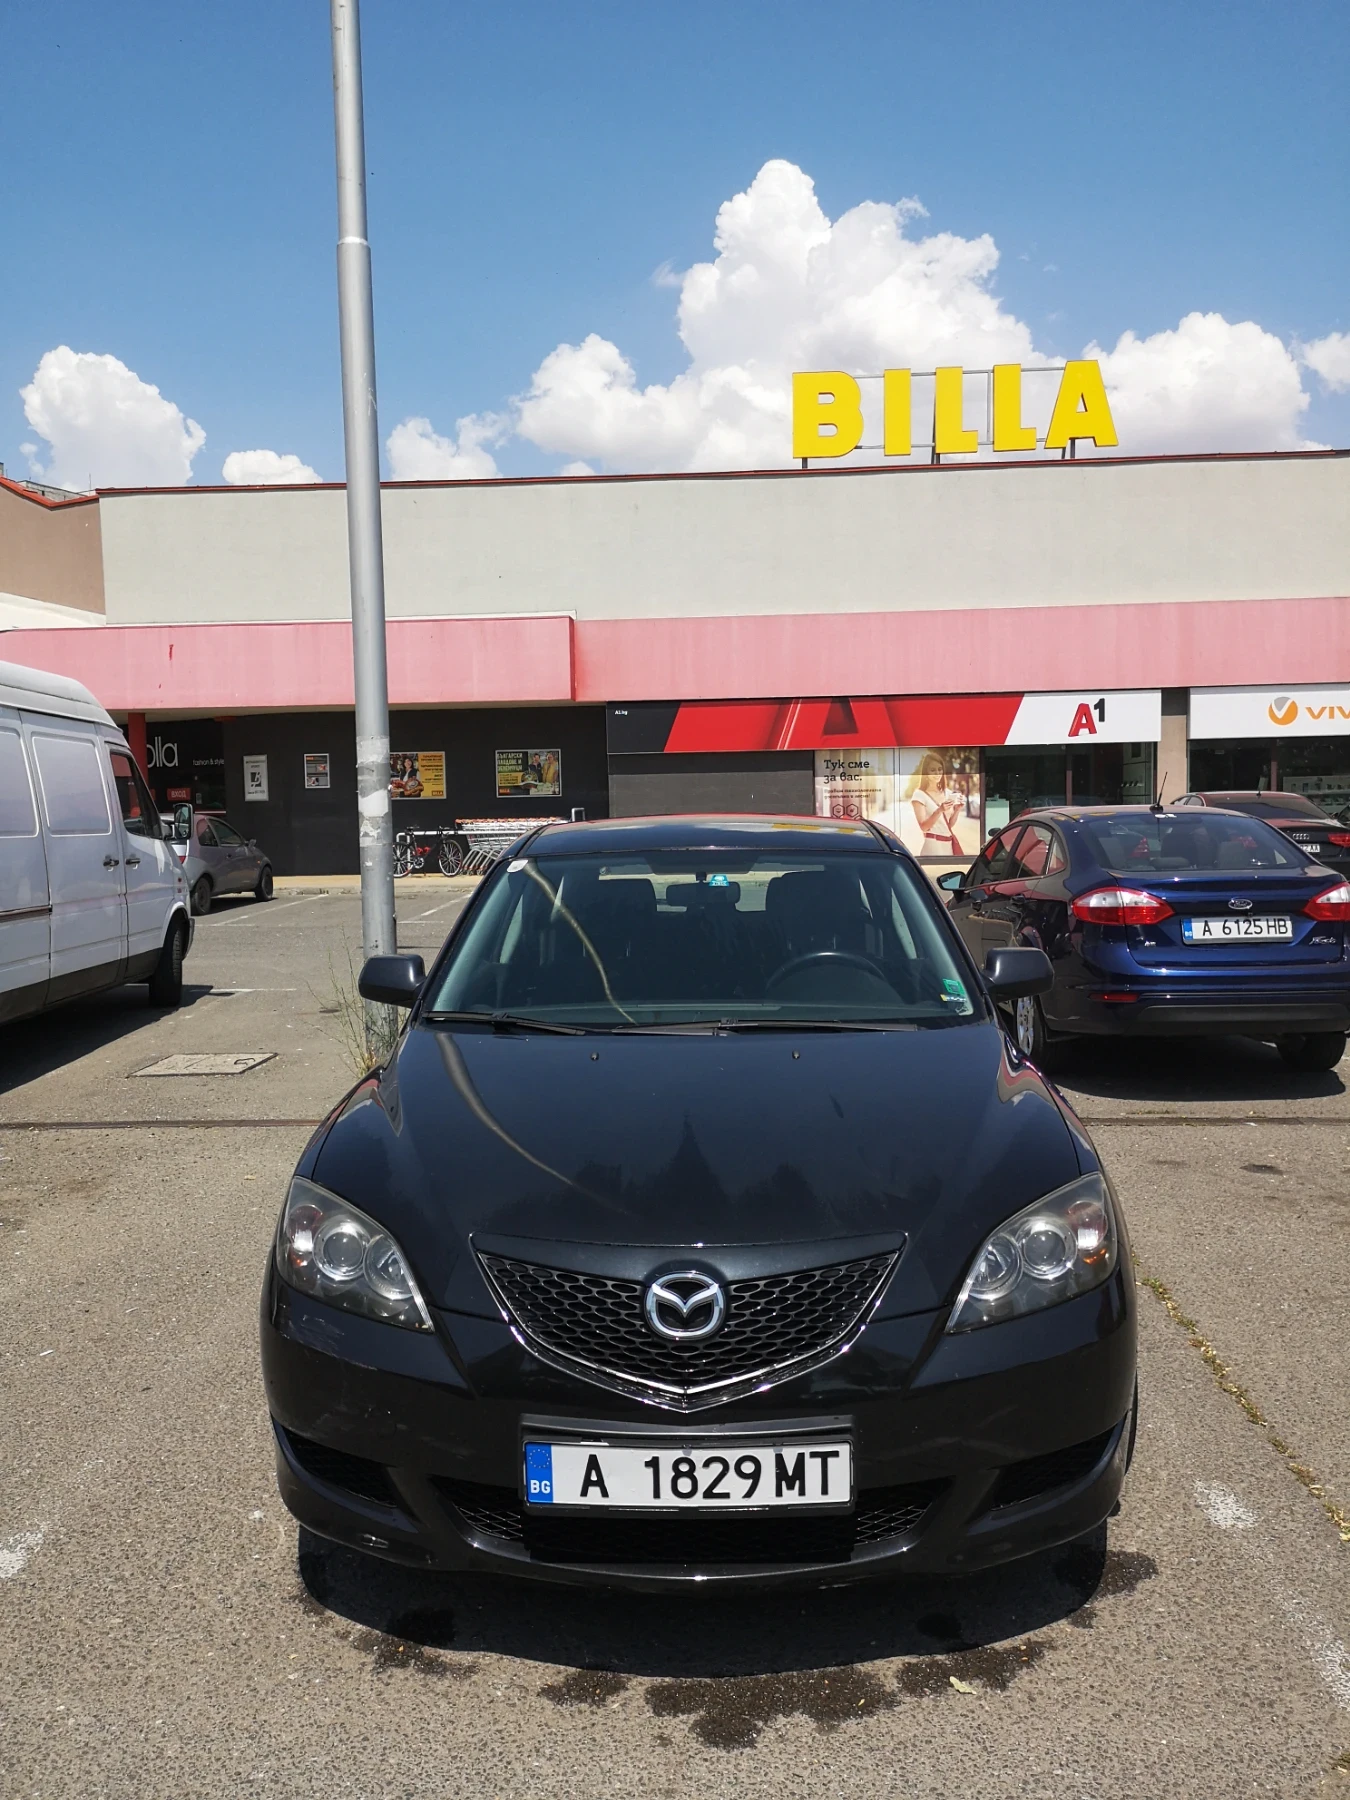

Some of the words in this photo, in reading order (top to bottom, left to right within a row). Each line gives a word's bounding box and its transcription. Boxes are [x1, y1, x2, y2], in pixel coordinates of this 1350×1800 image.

[792, 360, 1119, 459] BILLA
[1068, 698, 1105, 737] A1
[1305, 705, 1350, 720] VIV
[824, 759, 845, 771] Тук
[847, 761, 870, 769] сме
[824, 774, 837, 784] за
[840, 771, 863, 782] вас.
[171, 790, 187, 799] ВХОД
[1202, 920, 1212, 936] A
[1222, 919, 1263, 936] 6125
[1267, 918, 1288, 935] HB
[579, 1454, 610, 1498] A
[644, 1454, 762, 1499] 1829
[775, 1450, 840, 1498] MT
[530, 1479, 551, 1494] BG
